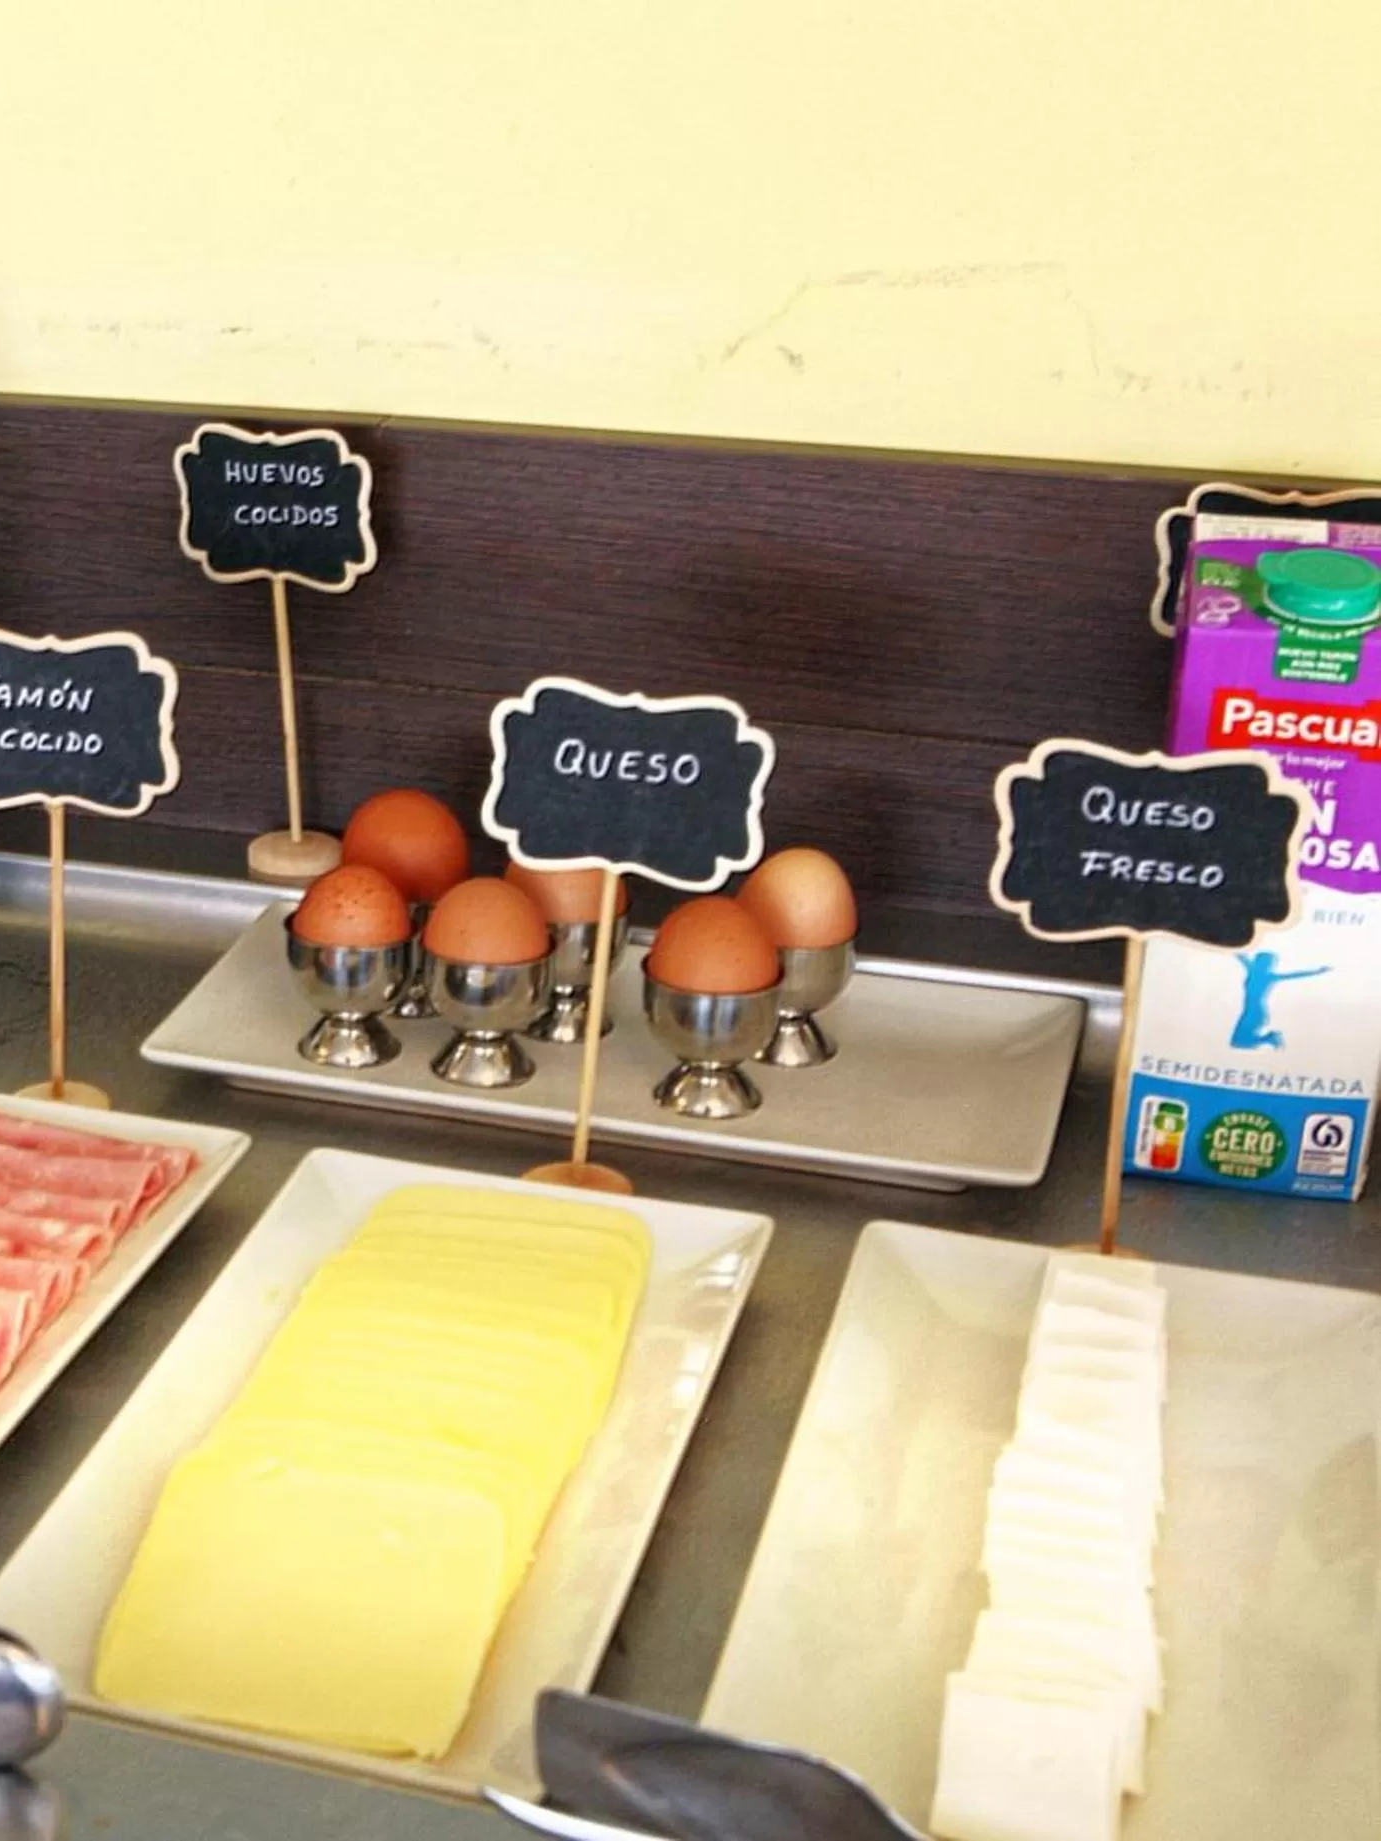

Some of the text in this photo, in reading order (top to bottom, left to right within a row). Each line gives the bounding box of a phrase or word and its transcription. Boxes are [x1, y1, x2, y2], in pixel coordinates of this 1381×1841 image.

[224, 459, 325, 487] HUEVOS
[233, 504, 339, 527] COCIDOS
[1221, 697, 1381, 749] Pascua
[553, 738, 701, 785] QUESO
[1081, 785, 1216, 832] QUESO
[1079, 849, 1225, 889] FRESCO
[1140, 1055, 1365, 1096] SEMIDESNATADA
[1213, 1125, 1276, 1155] CERO
